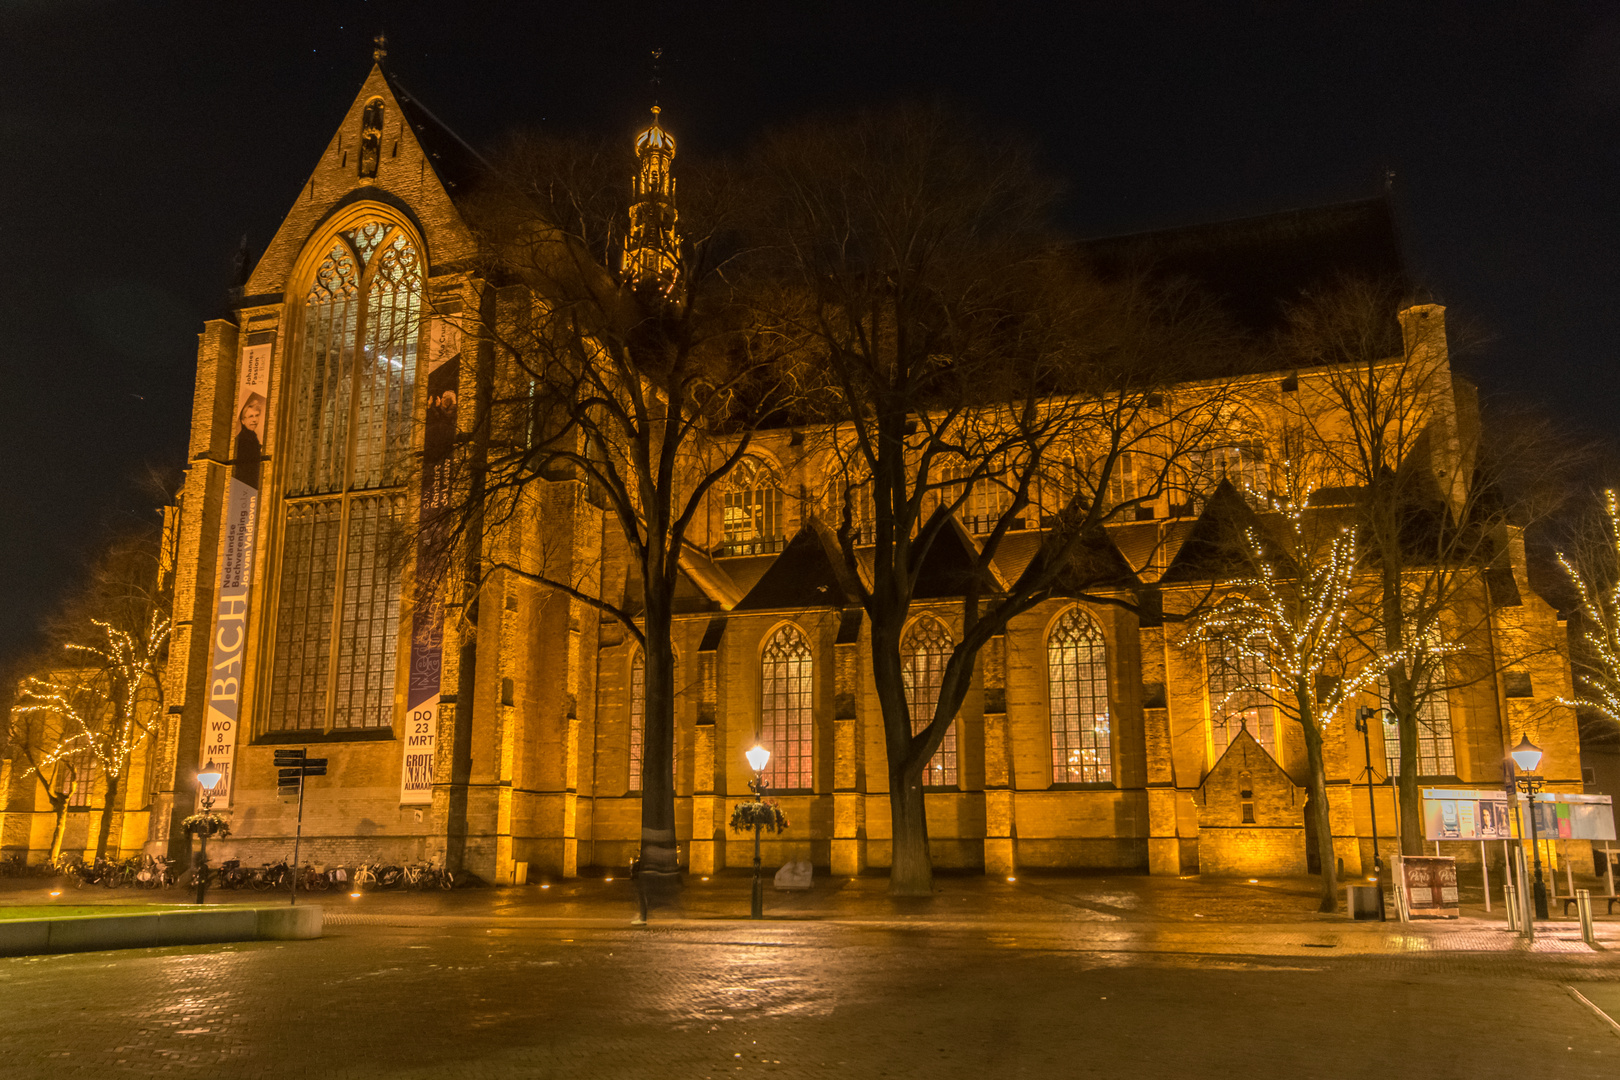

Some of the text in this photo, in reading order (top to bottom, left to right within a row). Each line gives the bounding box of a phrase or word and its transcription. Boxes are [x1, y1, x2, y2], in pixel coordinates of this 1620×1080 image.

[244, 496, 256, 549] Veldhoven
[232, 510, 248, 588] Bachvereniging
[223, 524, 236, 588] Nederlandse
[212, 592, 247, 704] BACH
[414, 710, 432, 721] DO
[212, 721, 231, 731] WO
[415, 724, 428, 734] 23
[216, 733, 223, 742] 8
[408, 735, 434, 746] MRT
[208, 744, 231, 754] MRT
[406, 754, 434, 767] GROTE
[404, 782, 432, 790] ALKMAAR
[1408, 870, 1430, 883] Paris
